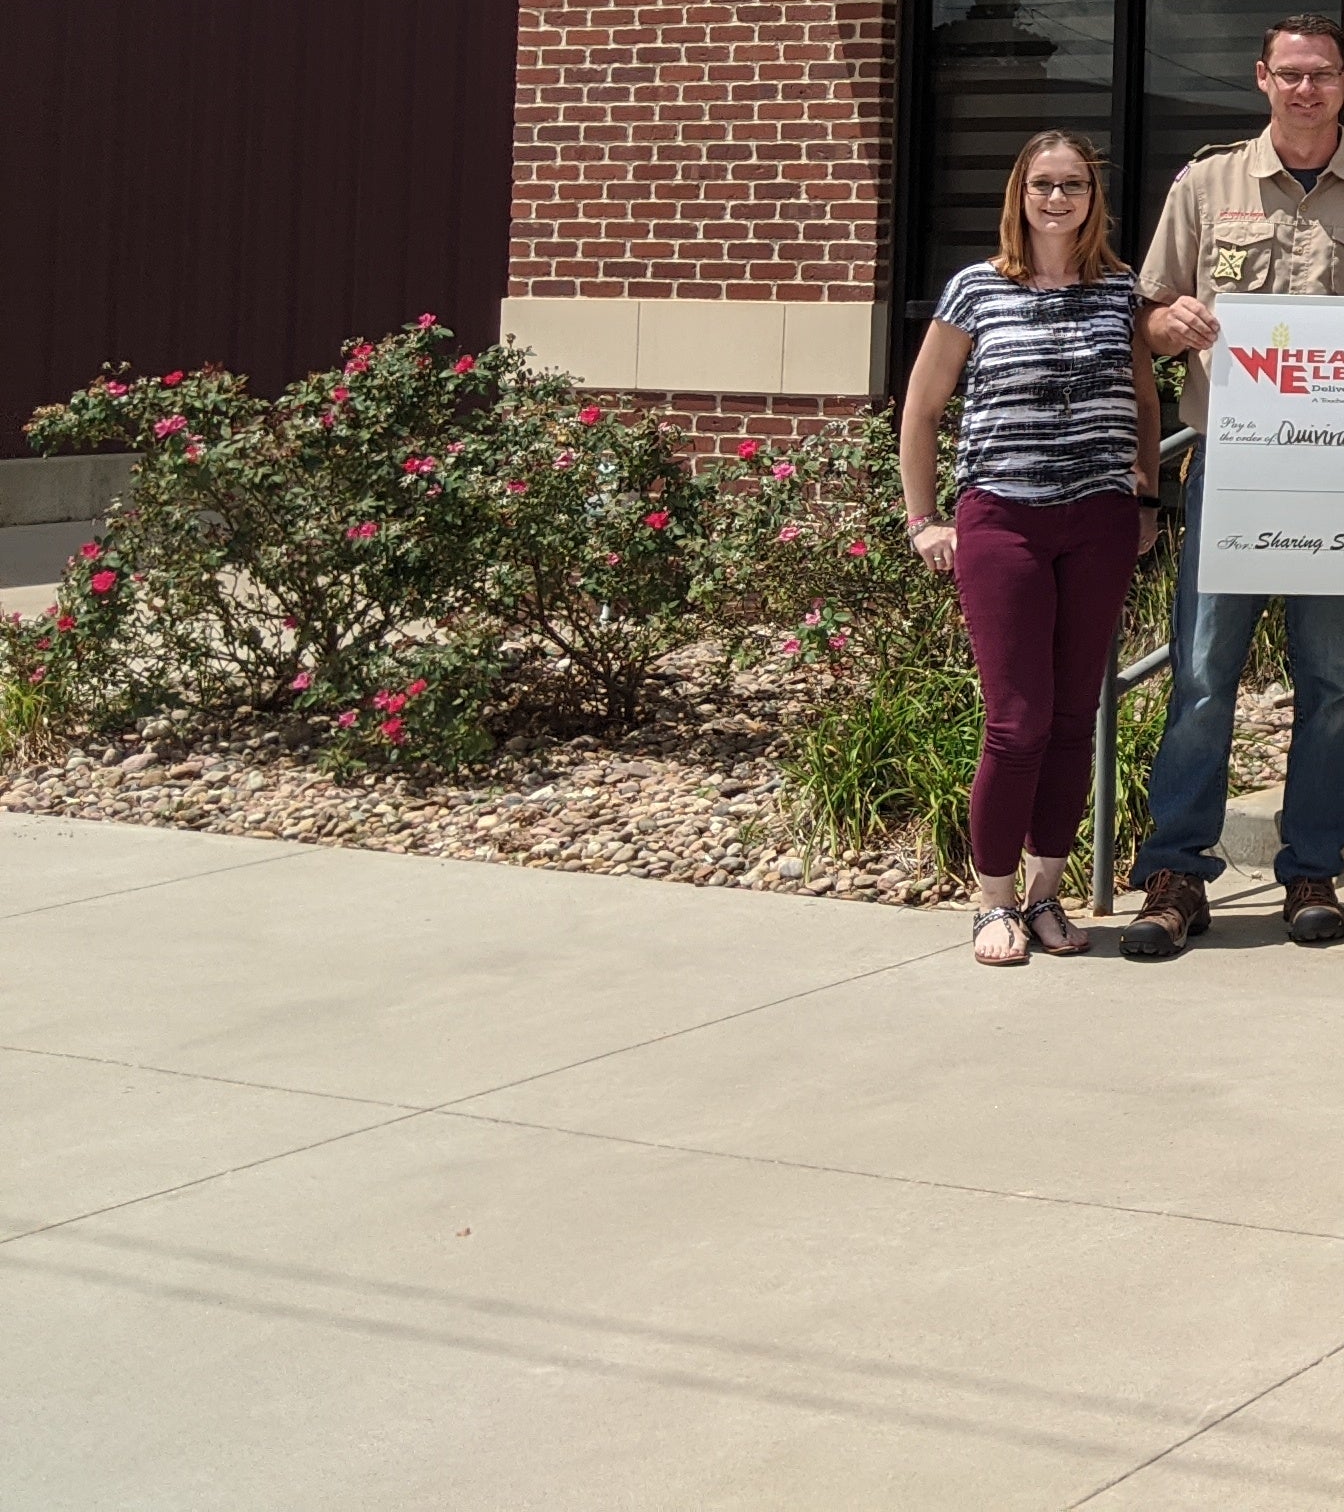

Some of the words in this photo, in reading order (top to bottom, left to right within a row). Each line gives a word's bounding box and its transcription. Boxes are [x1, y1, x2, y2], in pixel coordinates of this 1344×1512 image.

[1219, 416, 1245, 431] Pay
[1247, 421, 1257, 429] to
[1219, 431, 1234, 442] the
[1235, 433, 1258, 442] order
[1254, 530, 1324, 555] Sharing
